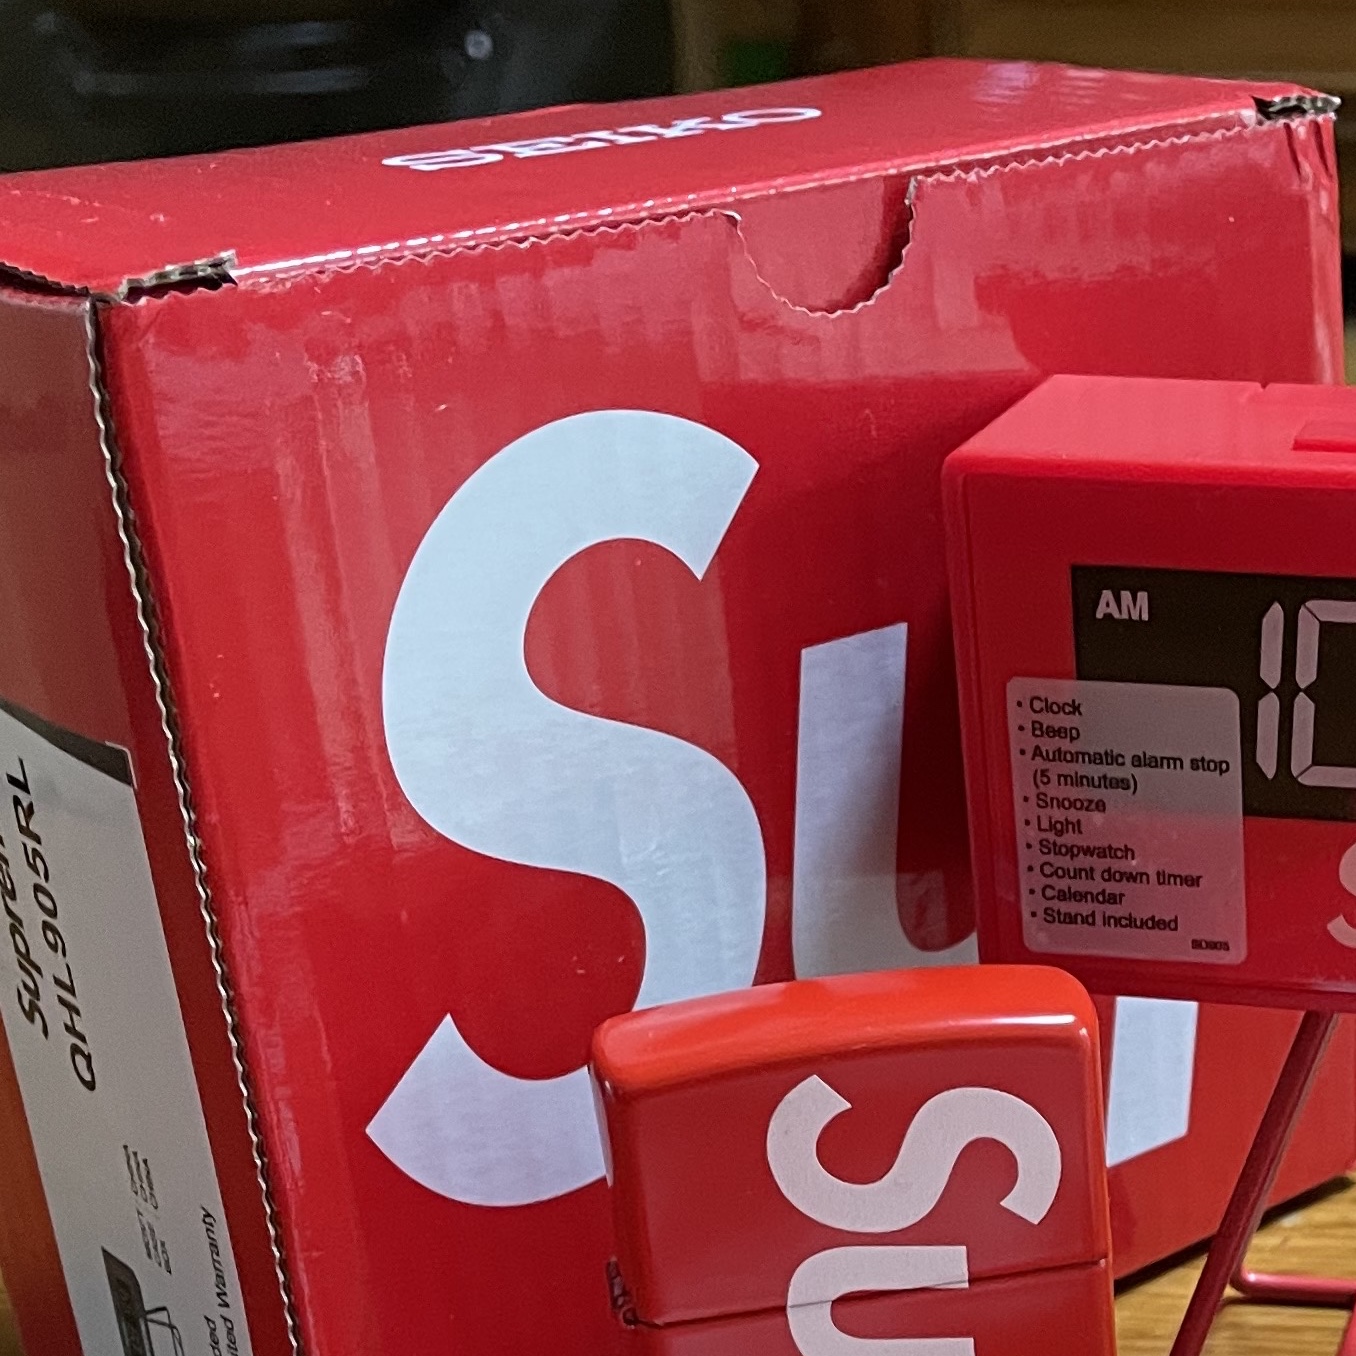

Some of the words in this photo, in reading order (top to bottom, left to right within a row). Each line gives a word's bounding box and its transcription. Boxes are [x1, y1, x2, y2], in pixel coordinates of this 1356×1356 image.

[1096, 590, 1149, 621] AM
[1029, 696, 1083, 716] Clock
[1031, 720, 1081, 742] Beep
[1031, 745, 1125, 767] Automatic
[1131, 750, 1184, 770] alarm
[1190, 756, 1230, 776] stop
[1033, 768, 1051, 789] (5
[1057, 771, 1138, 795] minutes)
[1036, 792, 1107, 813] Snooze
[1037, 815, 1083, 837] Light
[1039, 839, 1136, 861] Stopwatch
[1040, 862, 1095, 881] Count
[1101, 867, 1150, 885] down
[1156, 869, 1203, 887] timer
[1041, 885, 1126, 905] Calendar
[6, 758, 97, 1092] QHL905RL
[1043, 907, 1096, 927] Stand
[1103, 911, 1179, 931] included
[0, 835, 48, 1040] Supre
[200, 1204, 231, 1309] Warranty
